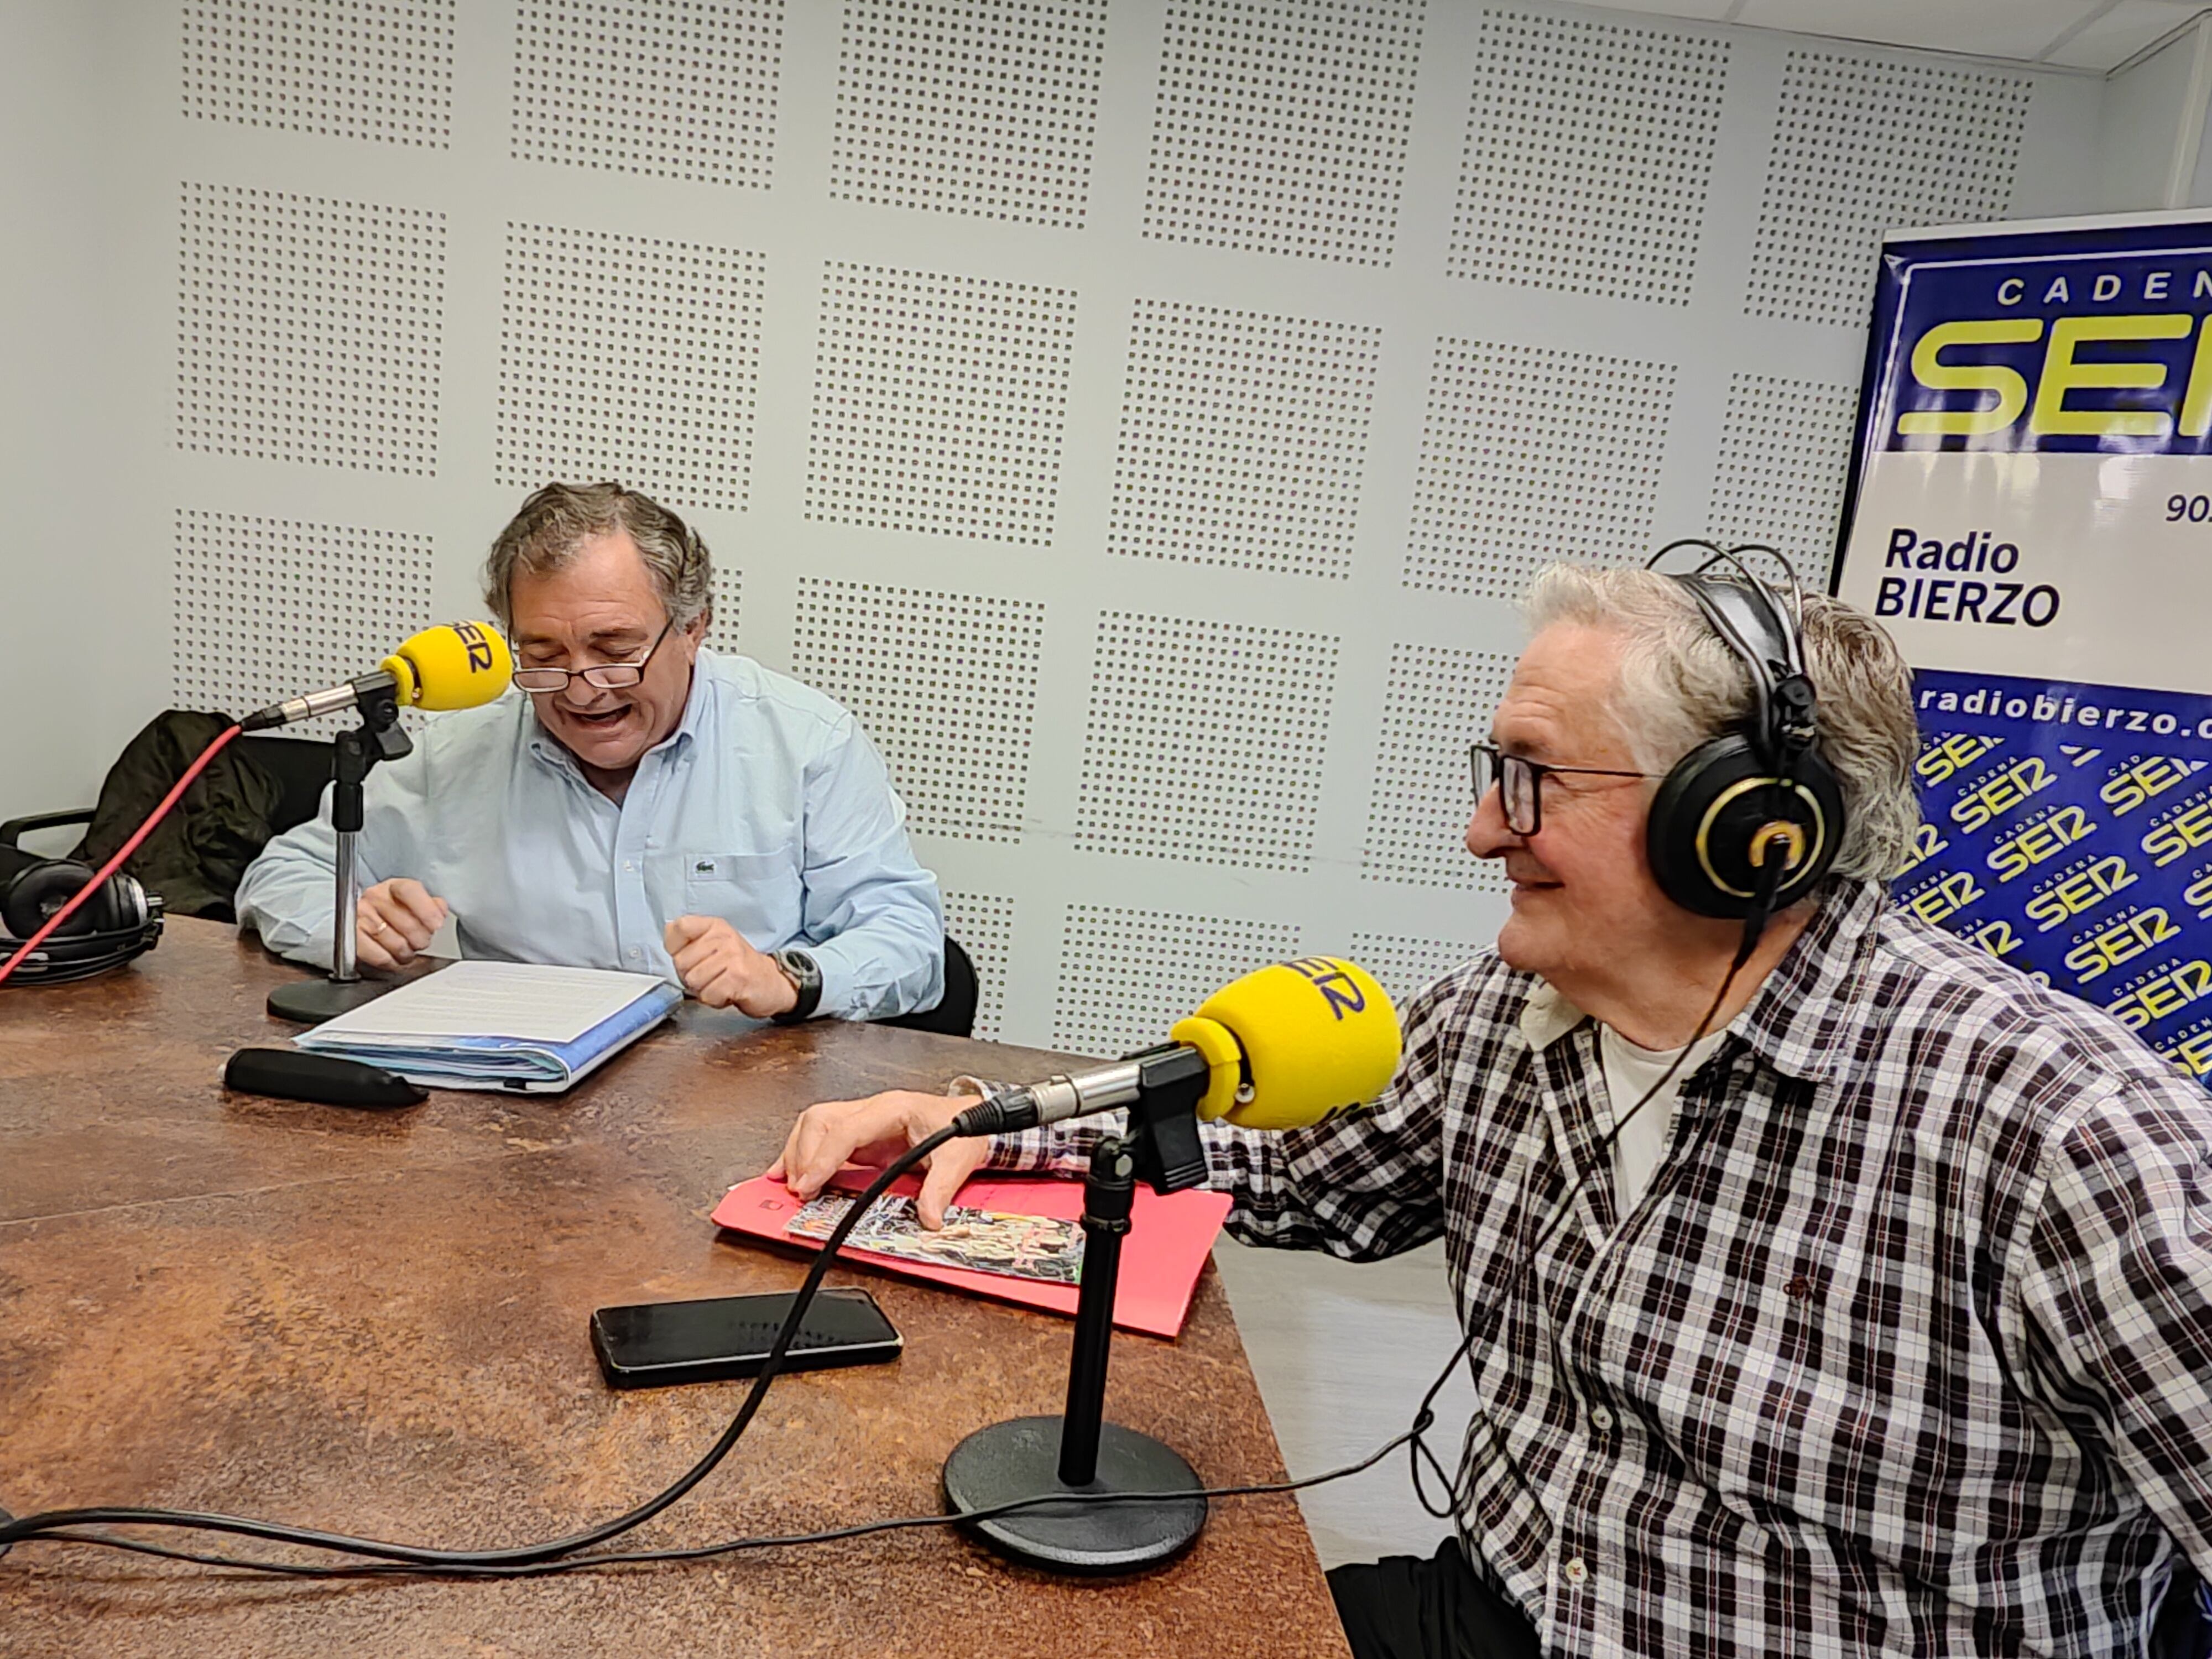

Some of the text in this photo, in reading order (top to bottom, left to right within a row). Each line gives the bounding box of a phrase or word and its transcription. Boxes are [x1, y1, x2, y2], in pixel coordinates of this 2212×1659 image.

[1897, 314, 2212, 436] SE
[1885, 528, 2019, 575] Radio
[1875, 577, 2060, 628] BIERZO
[453, 619, 493, 674] ER
[1950, 757, 2058, 834] SER
[1958, 757, 2018, 797] CADENA
[1987, 806, 2097, 883] SER
[1994, 805, 2057, 844] CADENA
[2025, 856, 2139, 932] SER
[2033, 854, 2096, 894] CADENA
[2064, 907, 2181, 984] SER
[2072, 905, 2138, 944] CADENA
[2112, 958, 2180, 997] CADENA
